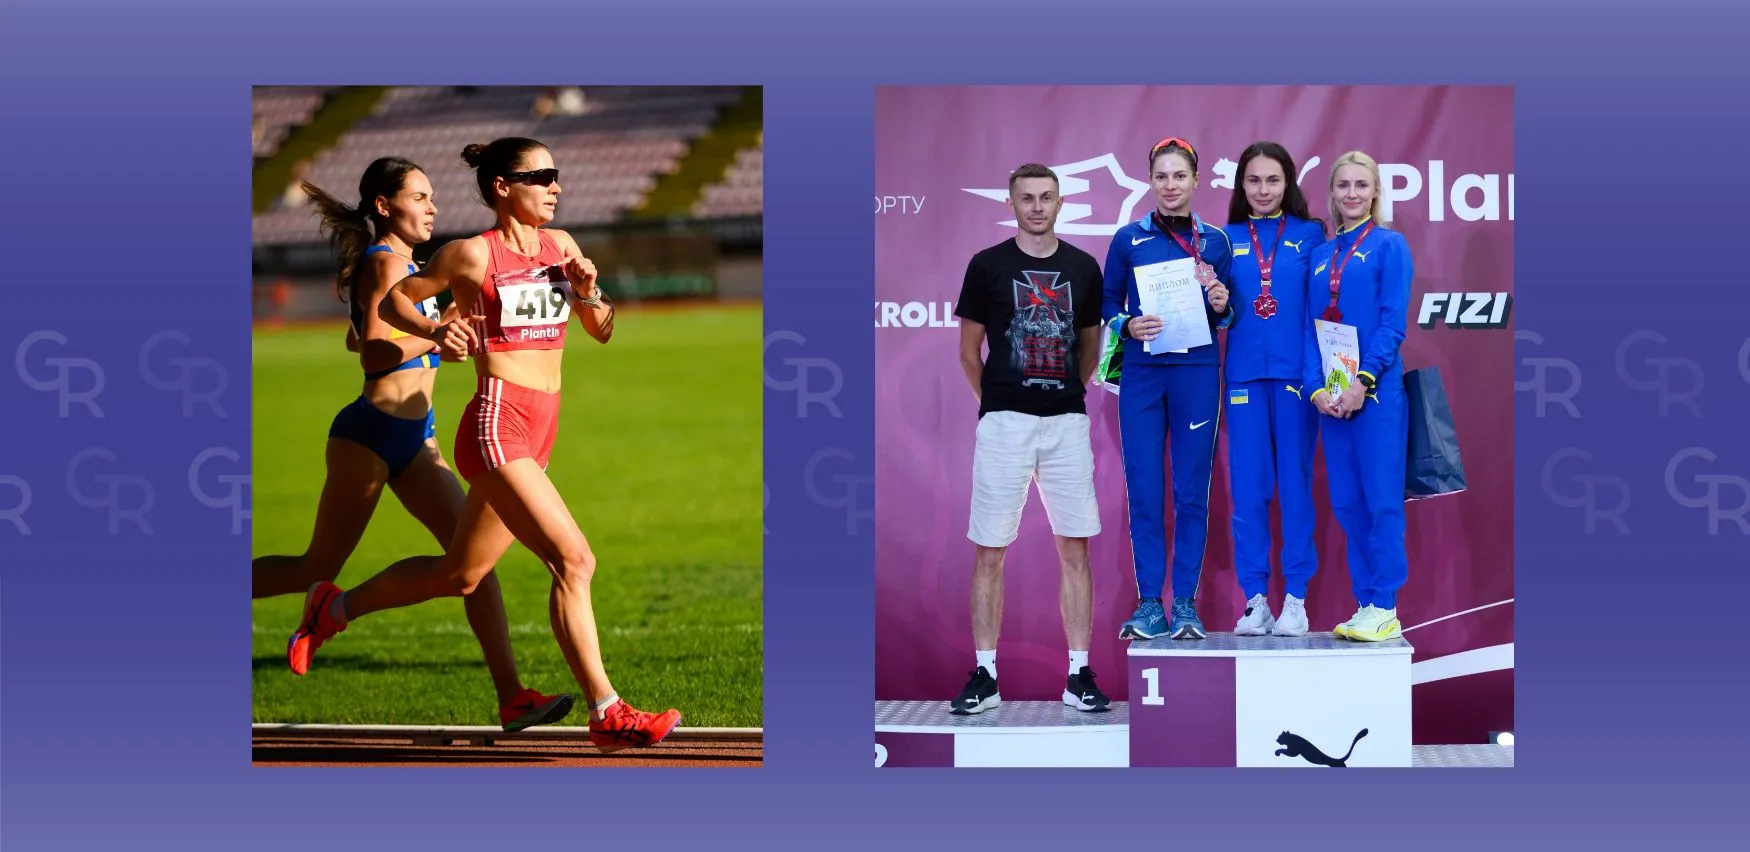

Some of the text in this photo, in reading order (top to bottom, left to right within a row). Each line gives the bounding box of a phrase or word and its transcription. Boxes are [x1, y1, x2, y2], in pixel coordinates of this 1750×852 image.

[516, 286, 566, 319] 419
[875, 301, 959, 328] ROLL
[1417, 292, 1511, 327] FIZI
[521, 327, 560, 340] Plantin
[1142, 668, 1164, 705] 1
